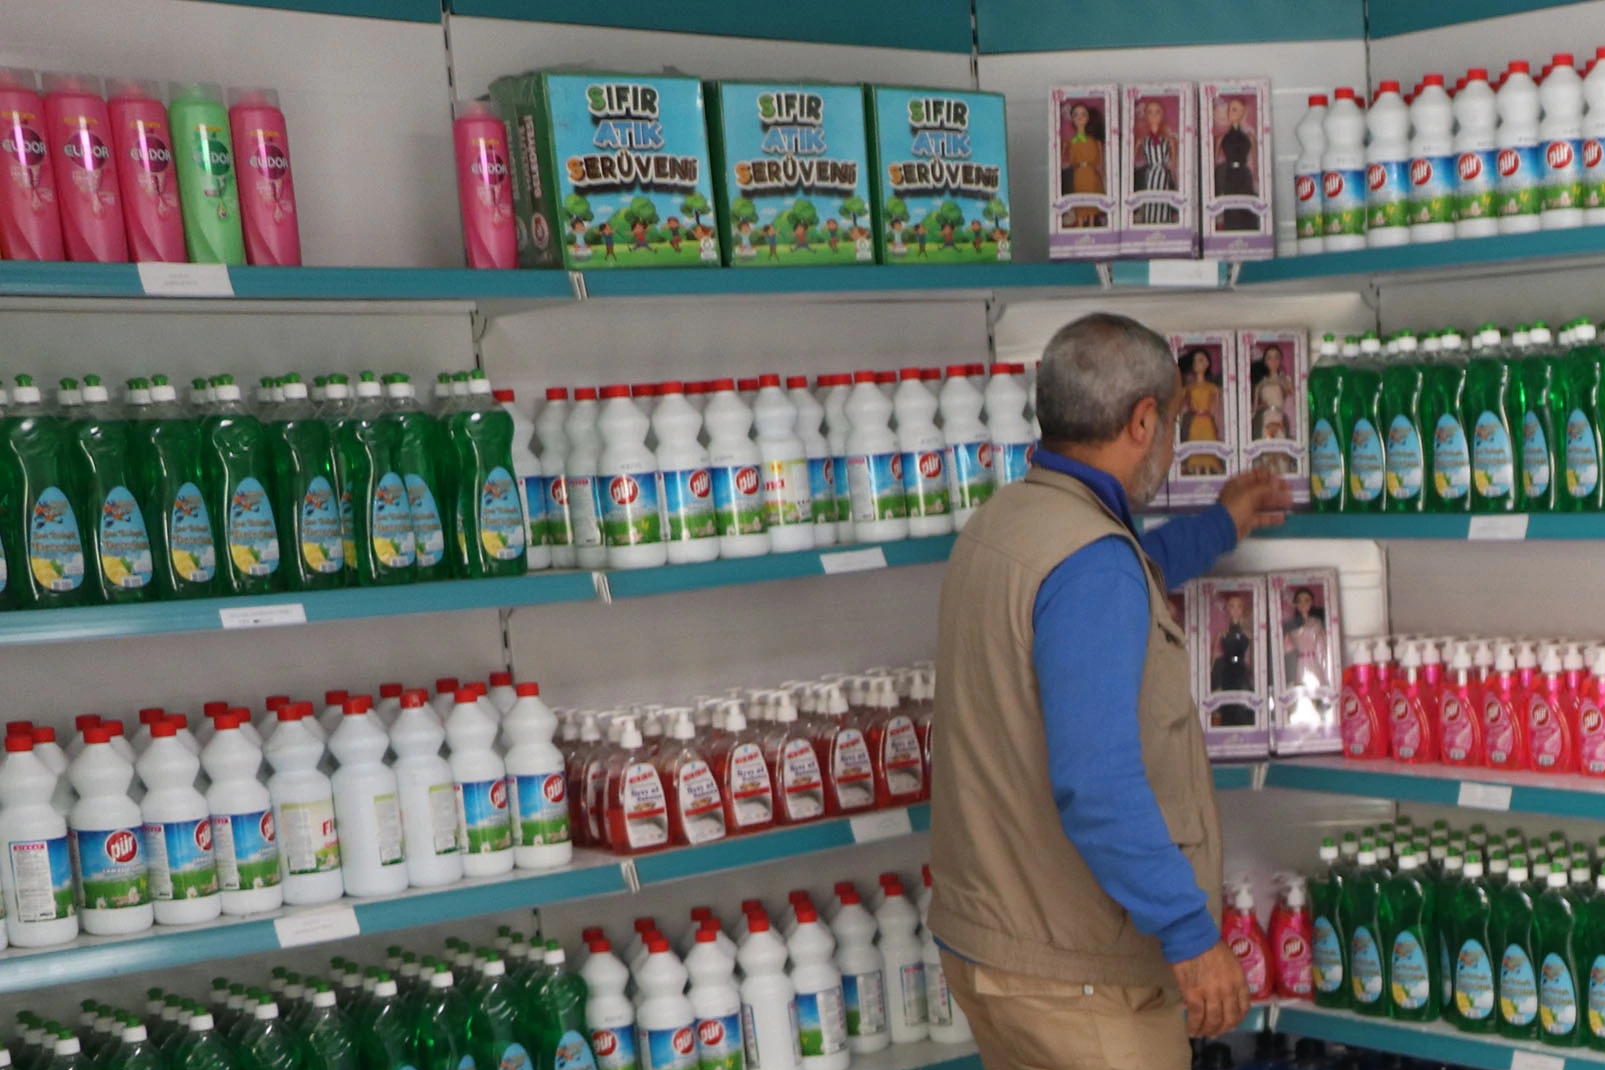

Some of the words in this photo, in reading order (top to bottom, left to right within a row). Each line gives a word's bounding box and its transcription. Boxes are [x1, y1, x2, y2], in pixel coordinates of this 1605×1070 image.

[587, 84, 659, 118] SIFIR
[759, 92, 824, 125] SIFIR
[909, 99, 968, 131] SIFIR
[595, 120, 663, 151] ATIK
[763, 127, 826, 155] ATIK
[912, 132, 971, 158] ATIK
[545, 778, 564, 800] pür
[109, 833, 134, 863] pür
